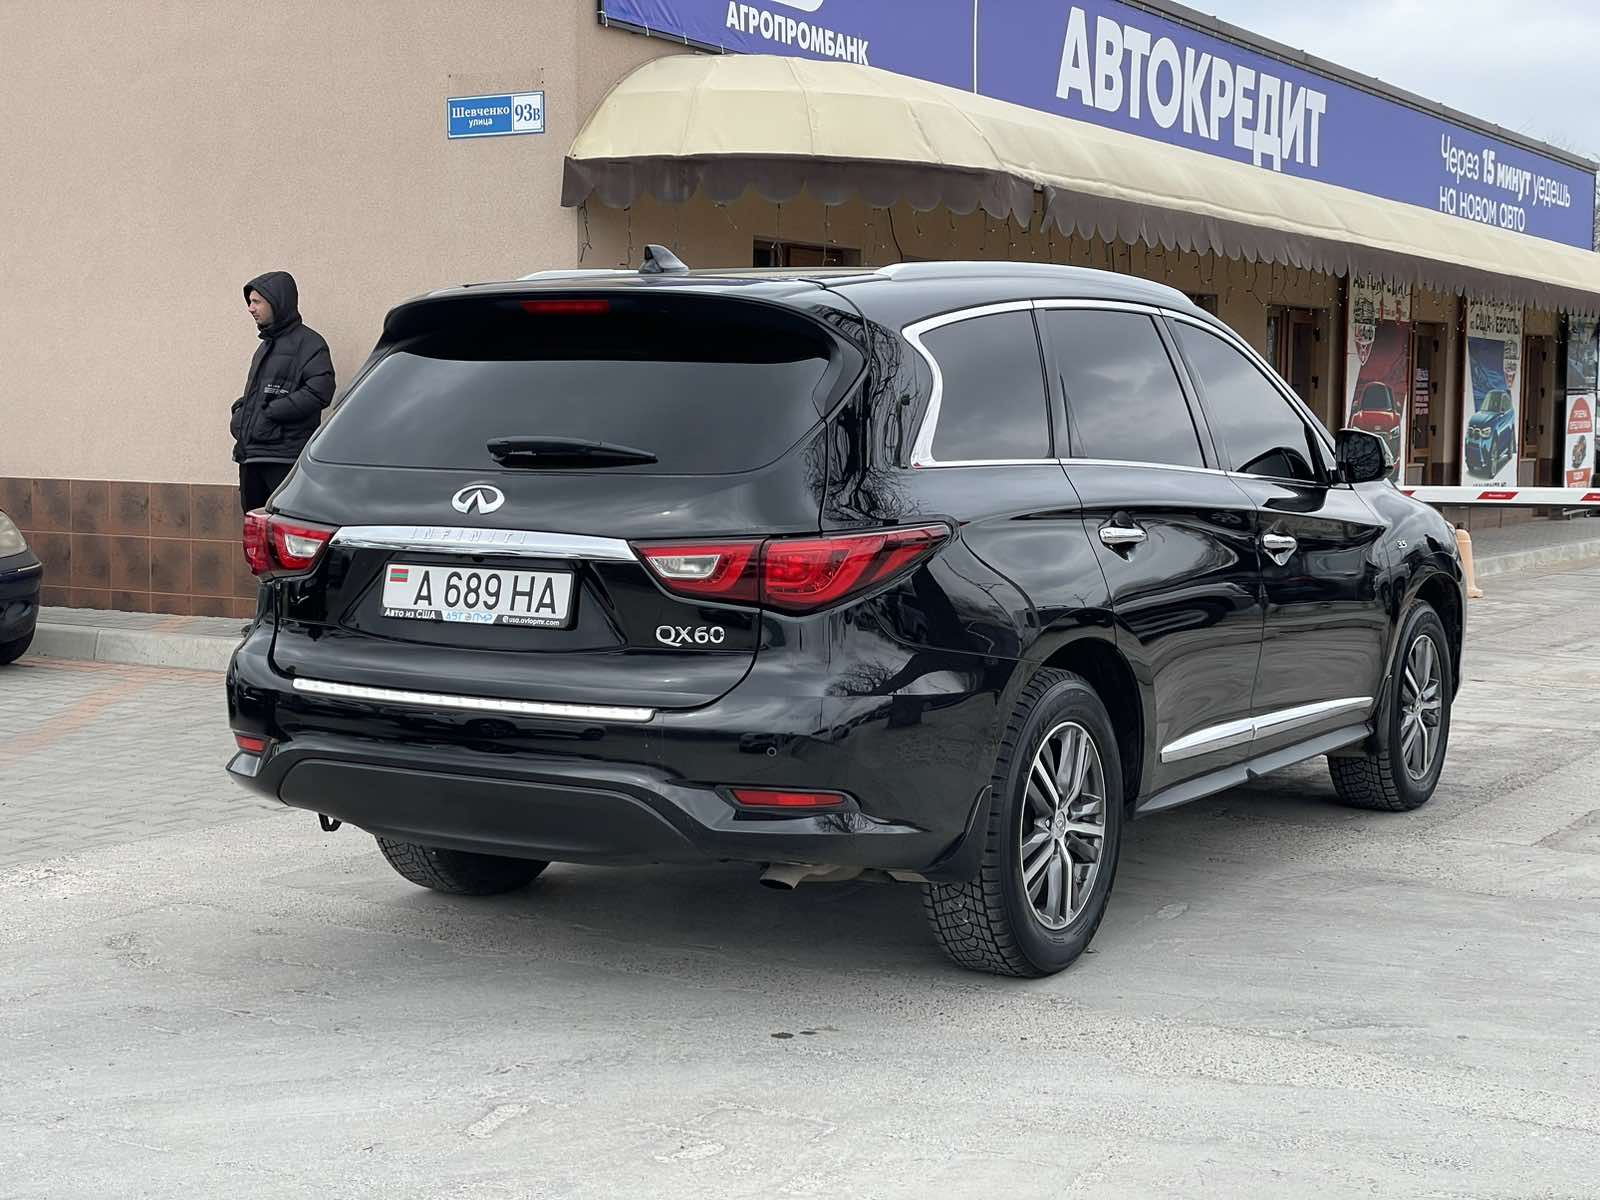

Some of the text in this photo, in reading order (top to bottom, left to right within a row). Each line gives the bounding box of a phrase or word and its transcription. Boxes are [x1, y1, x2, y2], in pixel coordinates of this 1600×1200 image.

[726, 1, 869, 66] АГРОПРОМБАНК
[1056, 6, 1327, 171] АВТОКРЕДИТ
[451, 105, 510, 119] Шевченко
[468, 117, 493, 129] улица
[1440, 133, 1571, 208] Через 15 минут уедешь
[1439, 185, 1526, 233] на новом авто
[409, 529, 528, 544] INFINITI
[413, 569, 557, 615] A 689 HA
[384, 607, 436, 620] Авто из США
[655, 625, 726, 647] QX60
